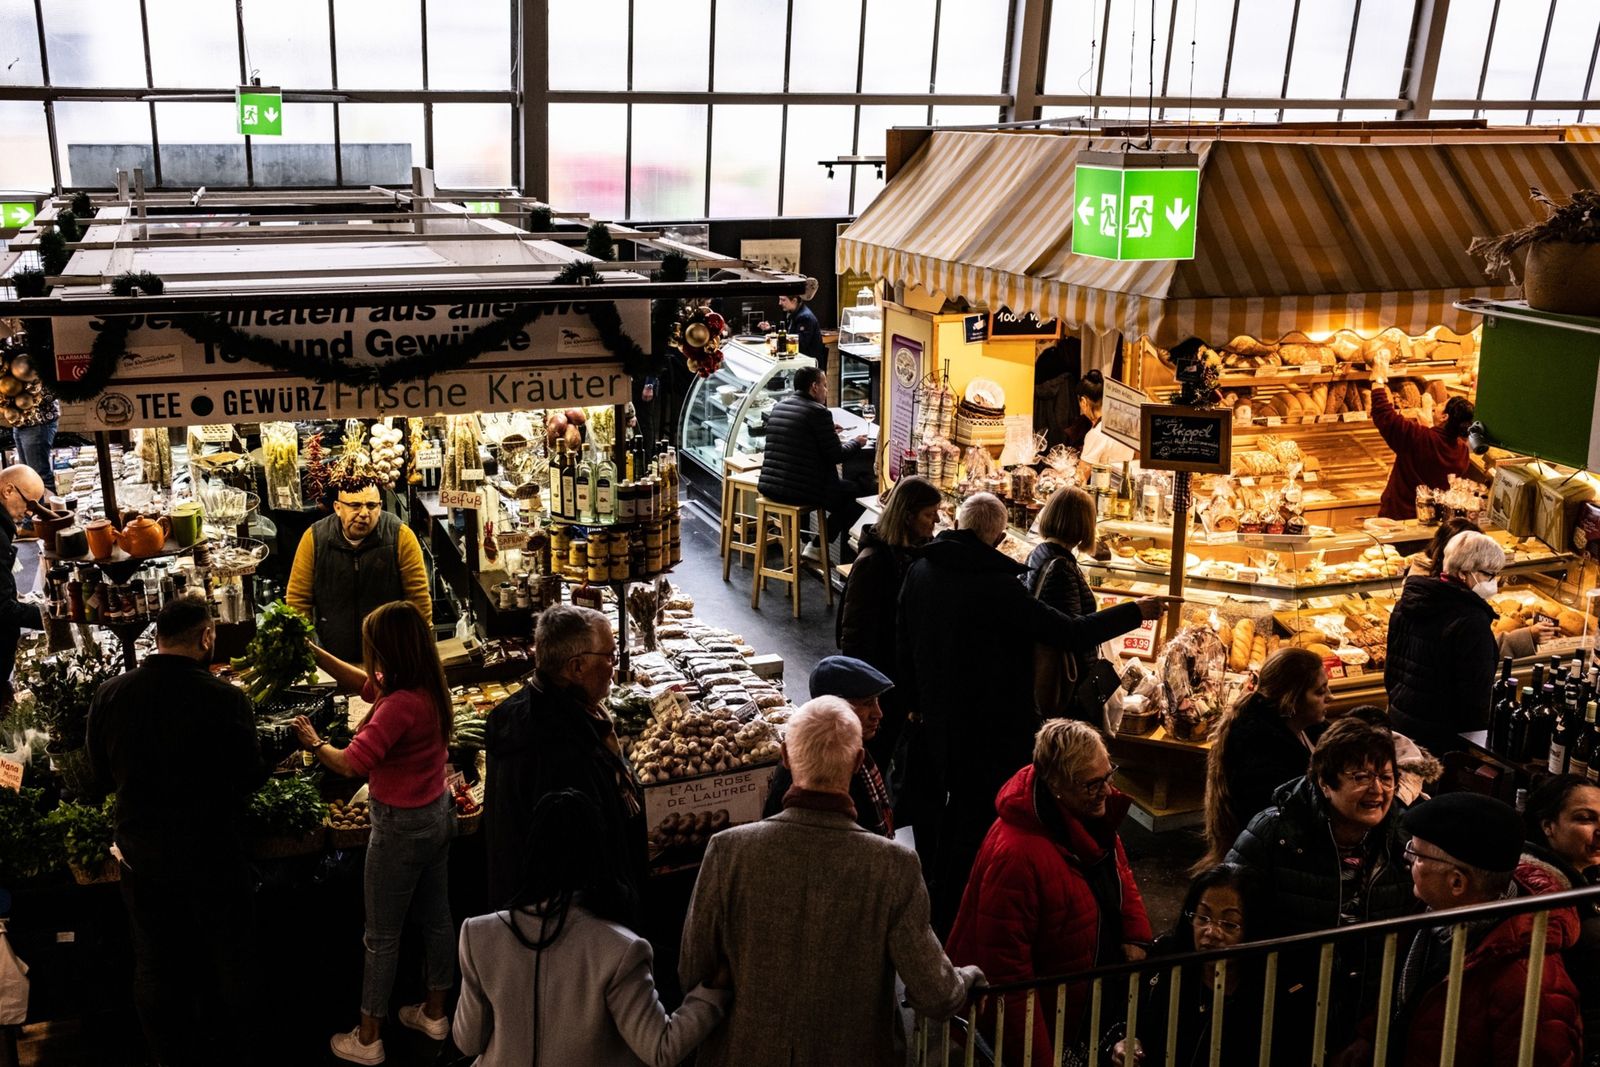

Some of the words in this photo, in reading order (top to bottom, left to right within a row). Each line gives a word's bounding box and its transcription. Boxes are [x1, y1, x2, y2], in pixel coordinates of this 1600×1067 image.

[448, 301, 524, 320] alle
[136, 392, 182, 419] TEE
[336, 376, 467, 410] Frische
[488, 371, 621, 405] Kräuter
[441, 491, 482, 507] Beifuß
[1, 759, 19, 773] Nana
[713, 773, 752, 788] ROSE
[667, 797, 686, 808] DE
[693, 782, 756, 803] LAUTREC
